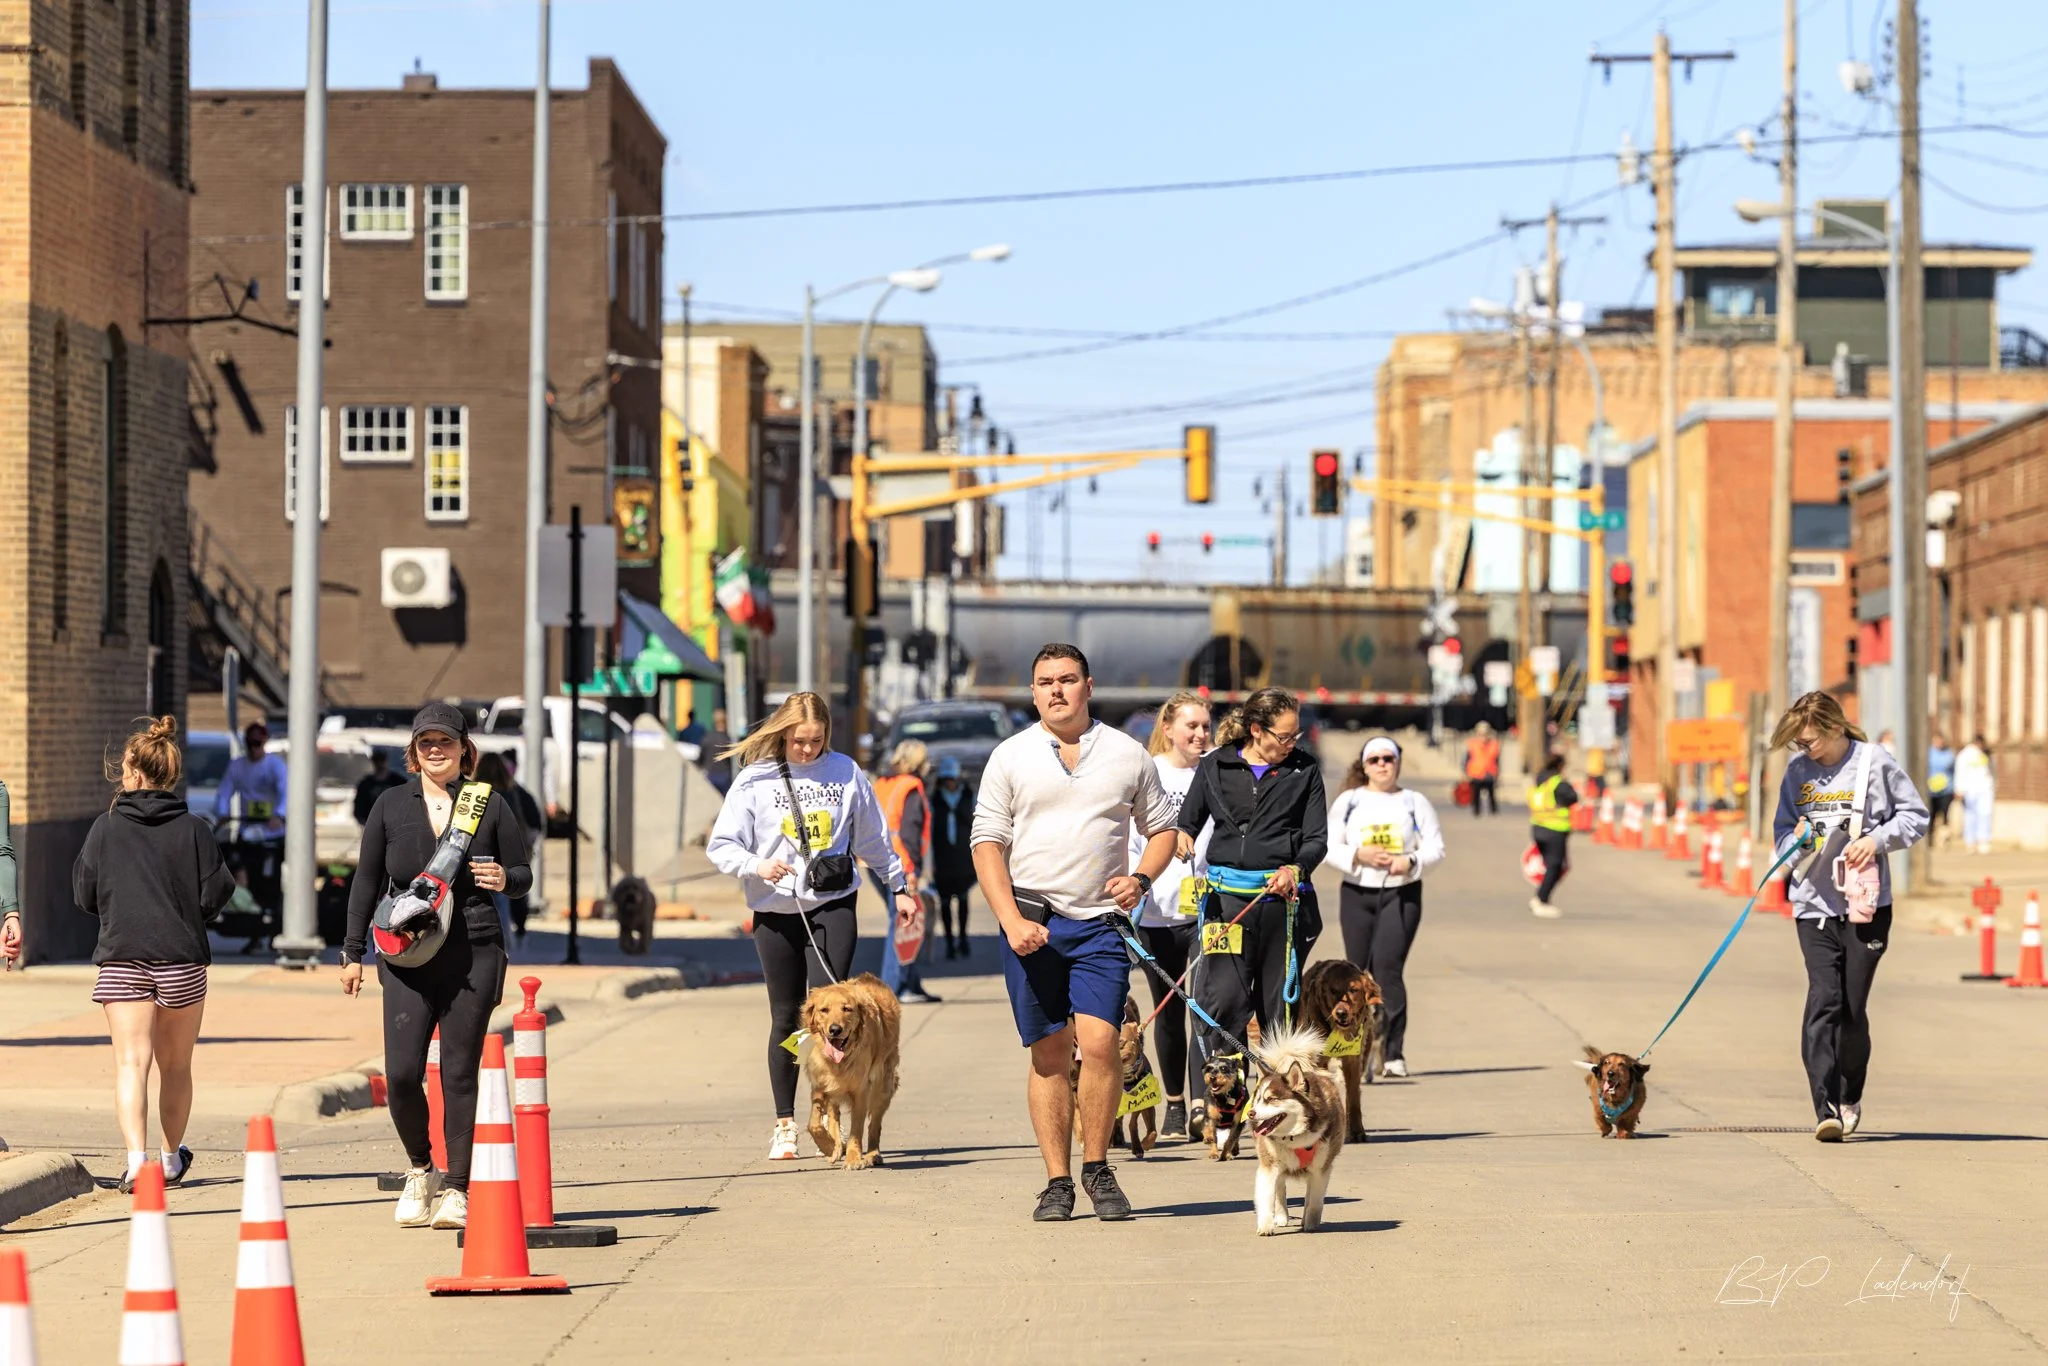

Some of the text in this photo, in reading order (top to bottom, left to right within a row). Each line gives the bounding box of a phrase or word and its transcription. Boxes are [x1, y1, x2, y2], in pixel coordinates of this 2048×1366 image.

[461, 792, 472, 802] 5K
[775, 789, 844, 804] VEERINARY
[1794, 783, 1855, 806] Bronc
[808, 814, 819, 822] 5K
[1138, 1081, 1148, 1092] 5K
